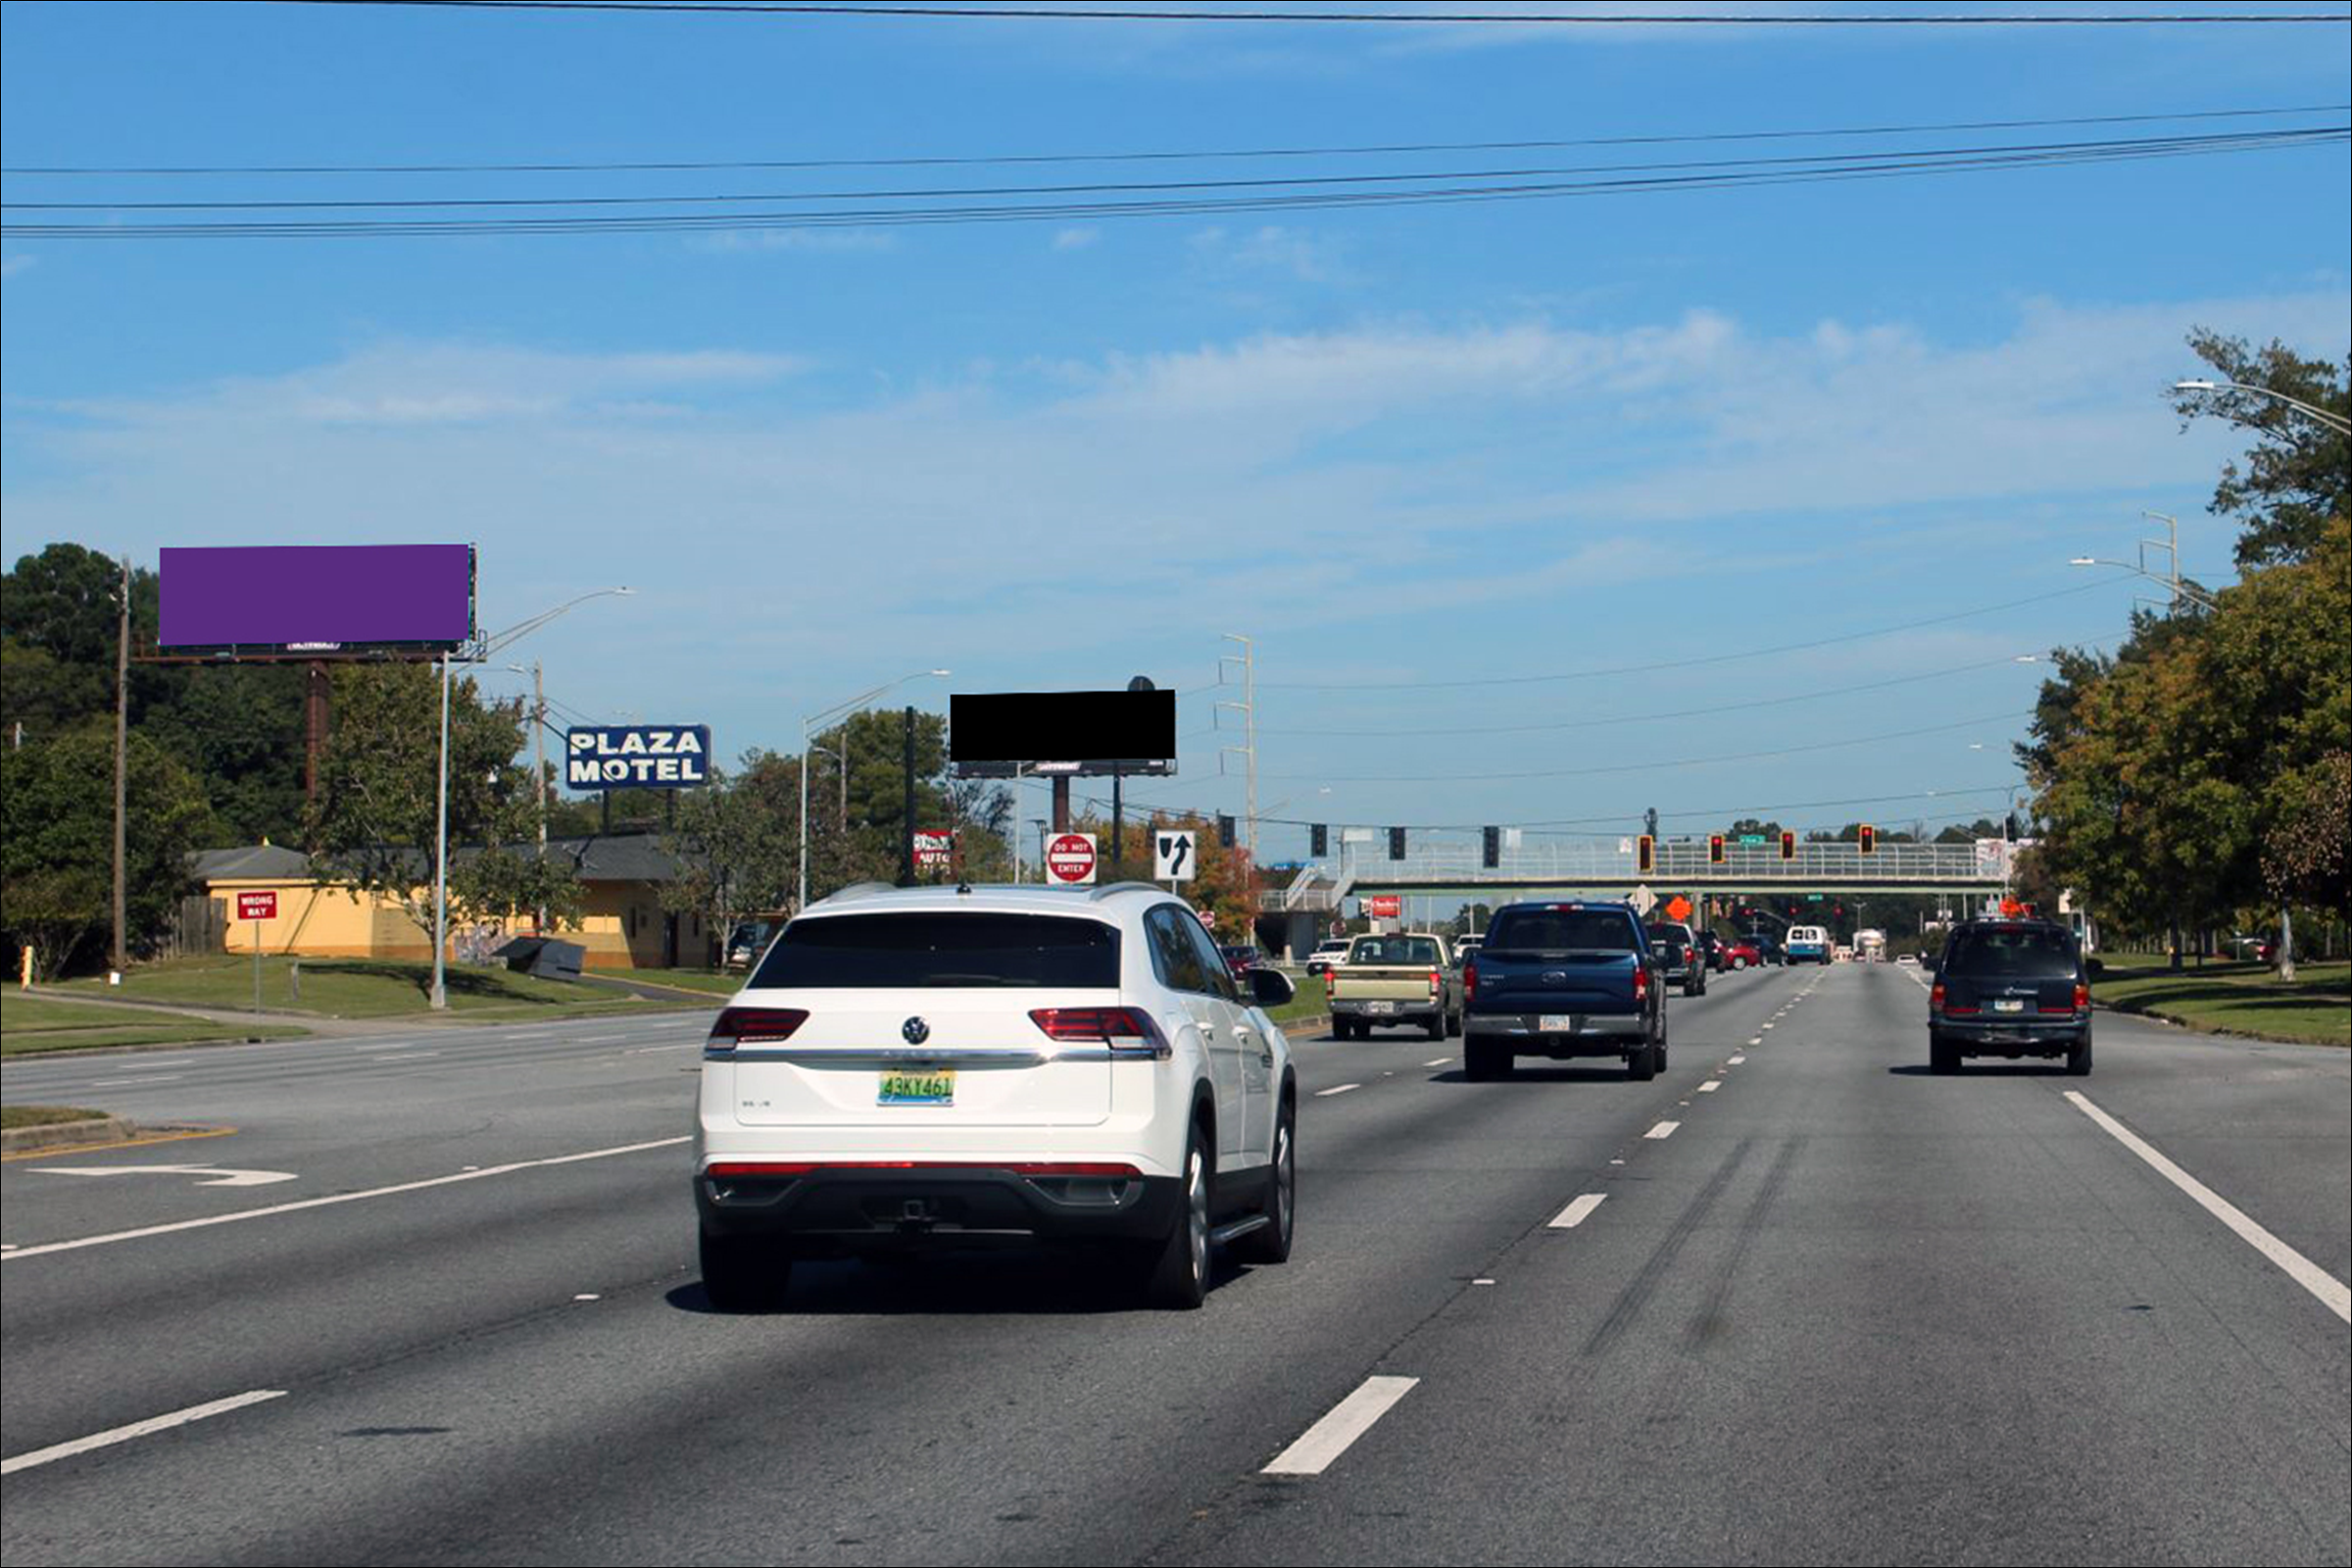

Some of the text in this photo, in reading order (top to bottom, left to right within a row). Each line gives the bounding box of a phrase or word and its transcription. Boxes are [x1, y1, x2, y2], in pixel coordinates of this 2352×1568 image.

[569, 732, 703, 755] PLAZA
[569, 759, 703, 782] MOTEL
[1054, 843, 1089, 852] DO NOT
[919, 852, 951, 863] AUTO
[1058, 863, 1085, 873] ENTER
[241, 896, 273, 906] WRONG
[247, 907, 266, 917] WAY
[884, 1077, 954, 1097] 43KY461
